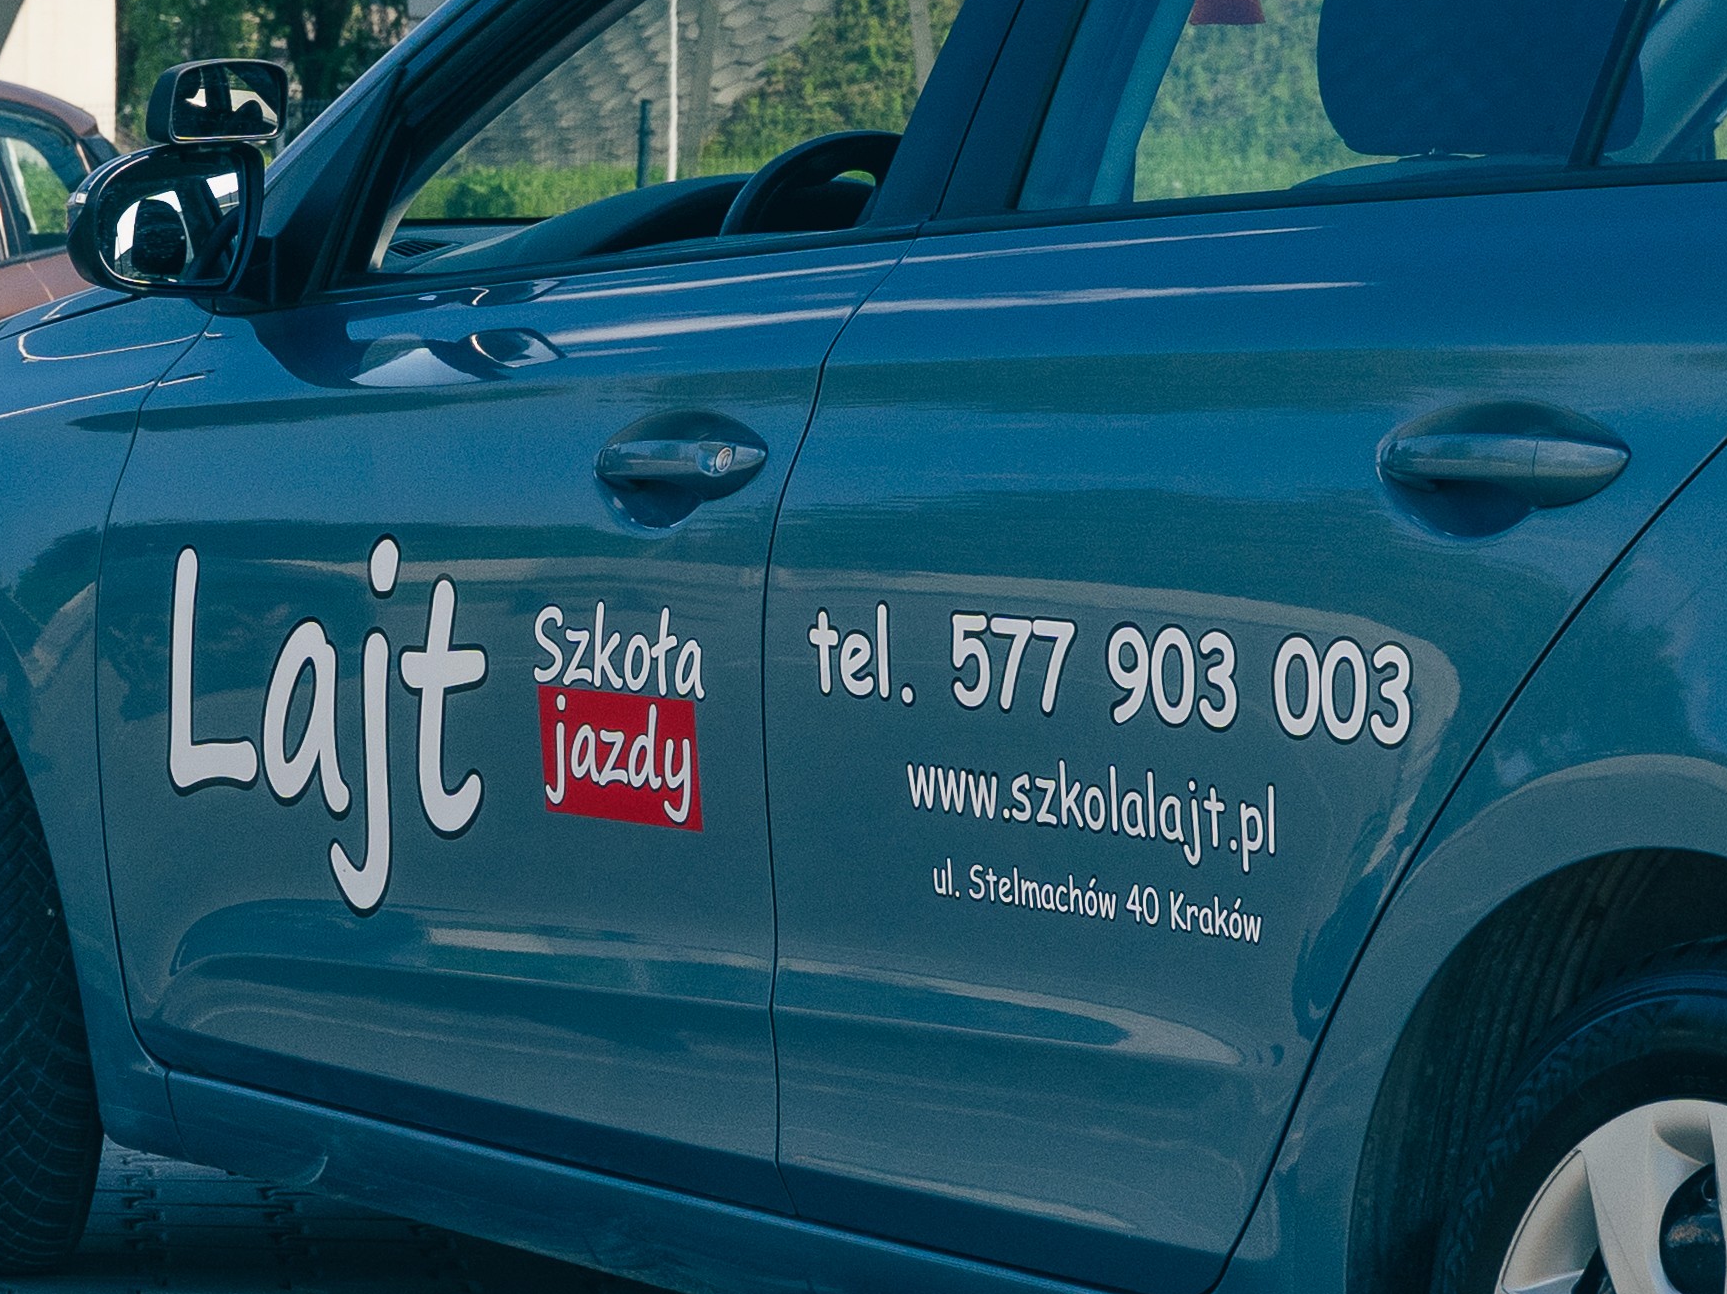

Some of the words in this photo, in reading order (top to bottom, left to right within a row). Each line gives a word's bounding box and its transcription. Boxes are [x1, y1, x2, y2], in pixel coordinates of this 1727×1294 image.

[533, 600, 706, 700] Szkoła
[808, 601, 915, 705] tel.
[950, 611, 1077, 715] 577
[1106, 621, 1239, 731] 903
[1272, 633, 1414, 747] 003
[168, 534, 488, 915] Lajt
[544, 693, 693, 824] jazdy
[907, 759, 1276, 872] www.szkolalajt.pl
[933, 857, 961, 900] ul.
[967, 864, 1117, 921] Stelmachów
[1125, 884, 1160, 926] 40
[1169, 891, 1263, 945] Kraków
